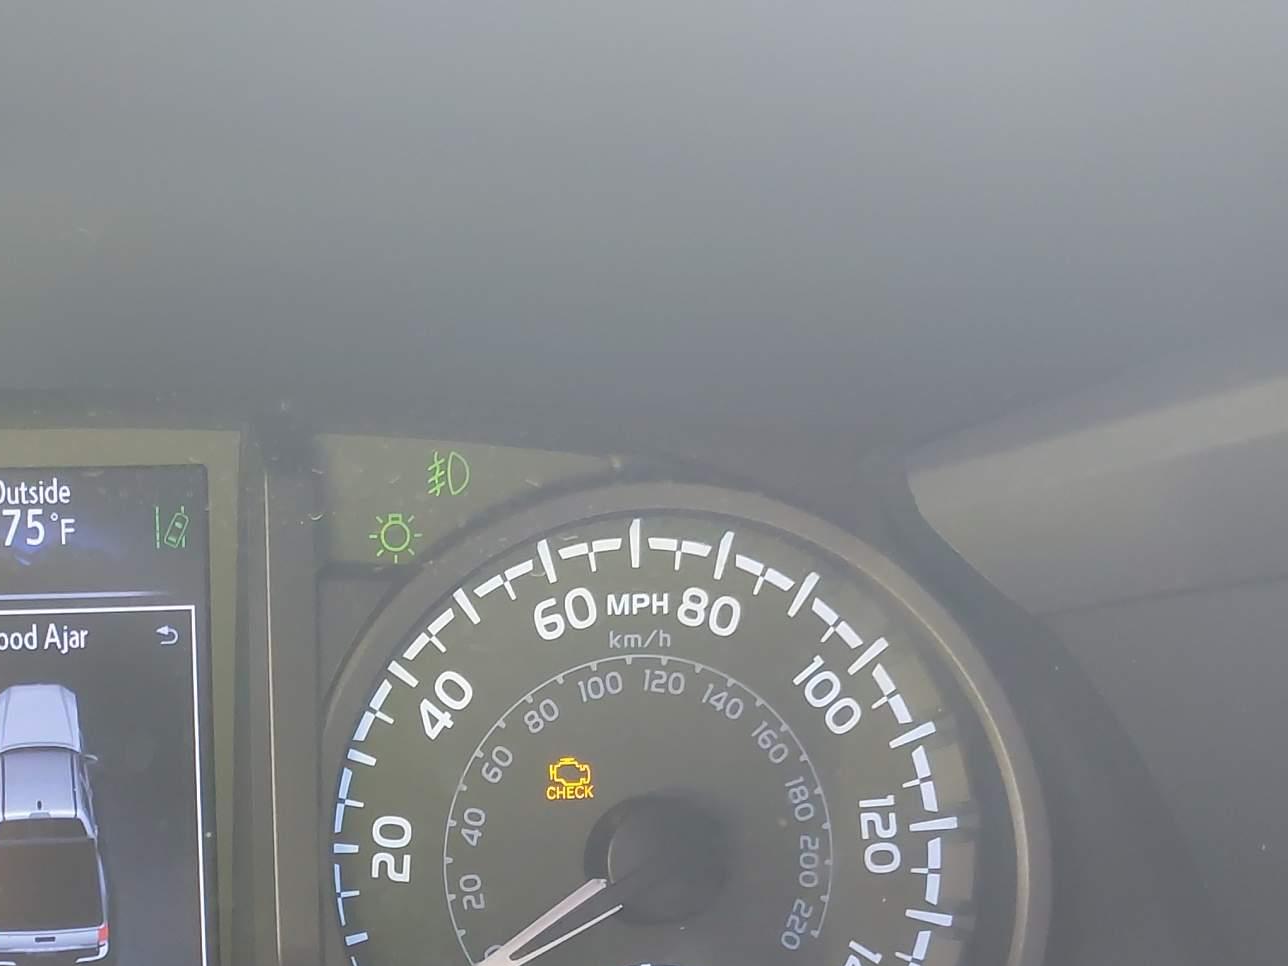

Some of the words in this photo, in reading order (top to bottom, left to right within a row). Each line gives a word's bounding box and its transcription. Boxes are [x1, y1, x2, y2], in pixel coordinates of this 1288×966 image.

[533, 587, 598, 642] 60
[606, 592, 669, 617] MPH
[676, 587, 741, 637] 80
[43, 622, 89, 655] Ajar
[608, 629, 672, 650] km/h
[577, 671, 623, 703] 100
[643, 668, 686, 695] 120
[702, 683, 745, 720] 140
[792, 653, 863, 735] 100
[418, 670, 473, 740] 40
[523, 698, 560, 734] 80
[751, 720, 789, 764] 160
[481, 745, 513, 784] 60
[546, 785, 594, 800] CHECK
[784, 776, 815, 822] 180
[460, 807, 486, 847] 40
[858, 794, 901, 874] 120
[371, 815, 412, 883] 20
[798, 835, 820, 888] 200
[459, 874, 485, 910] 20
[780, 898, 814, 950] 220
